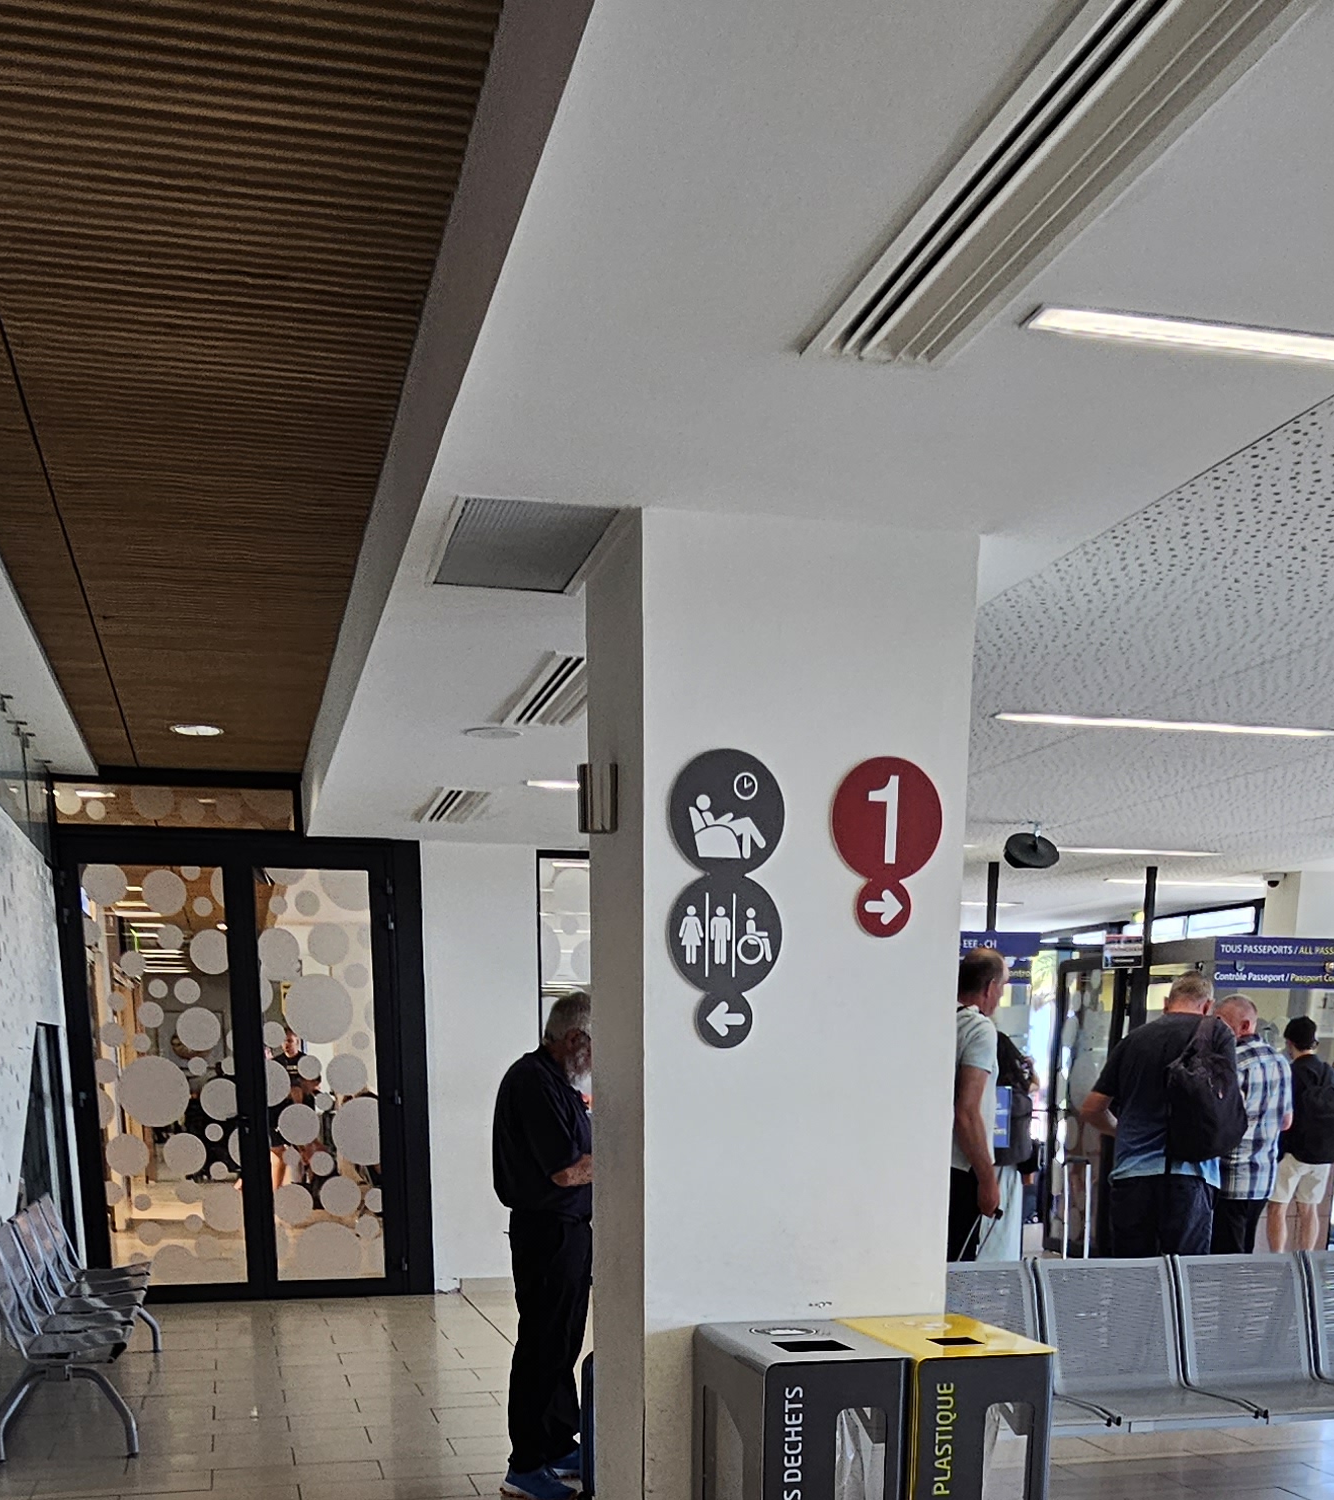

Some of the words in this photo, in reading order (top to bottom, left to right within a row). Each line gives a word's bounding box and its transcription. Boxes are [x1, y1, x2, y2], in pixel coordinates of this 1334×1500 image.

[868, 774, 900, 865] 1
[984, 939, 998, 949] CH
[1221, 943, 1241, 953] TOUS
[1243, 944, 1293, 955] PASSEPORTS
[1299, 945, 1314, 955] ALL
[1213, 971, 1247, 982] Contrôle
[1247, 972, 1285, 983] Passeport
[1290, 973, 1323, 984] Passport
[783, 1385, 804, 1484] DECHETS
[933, 1382, 957, 1495] PLASTIQUE
